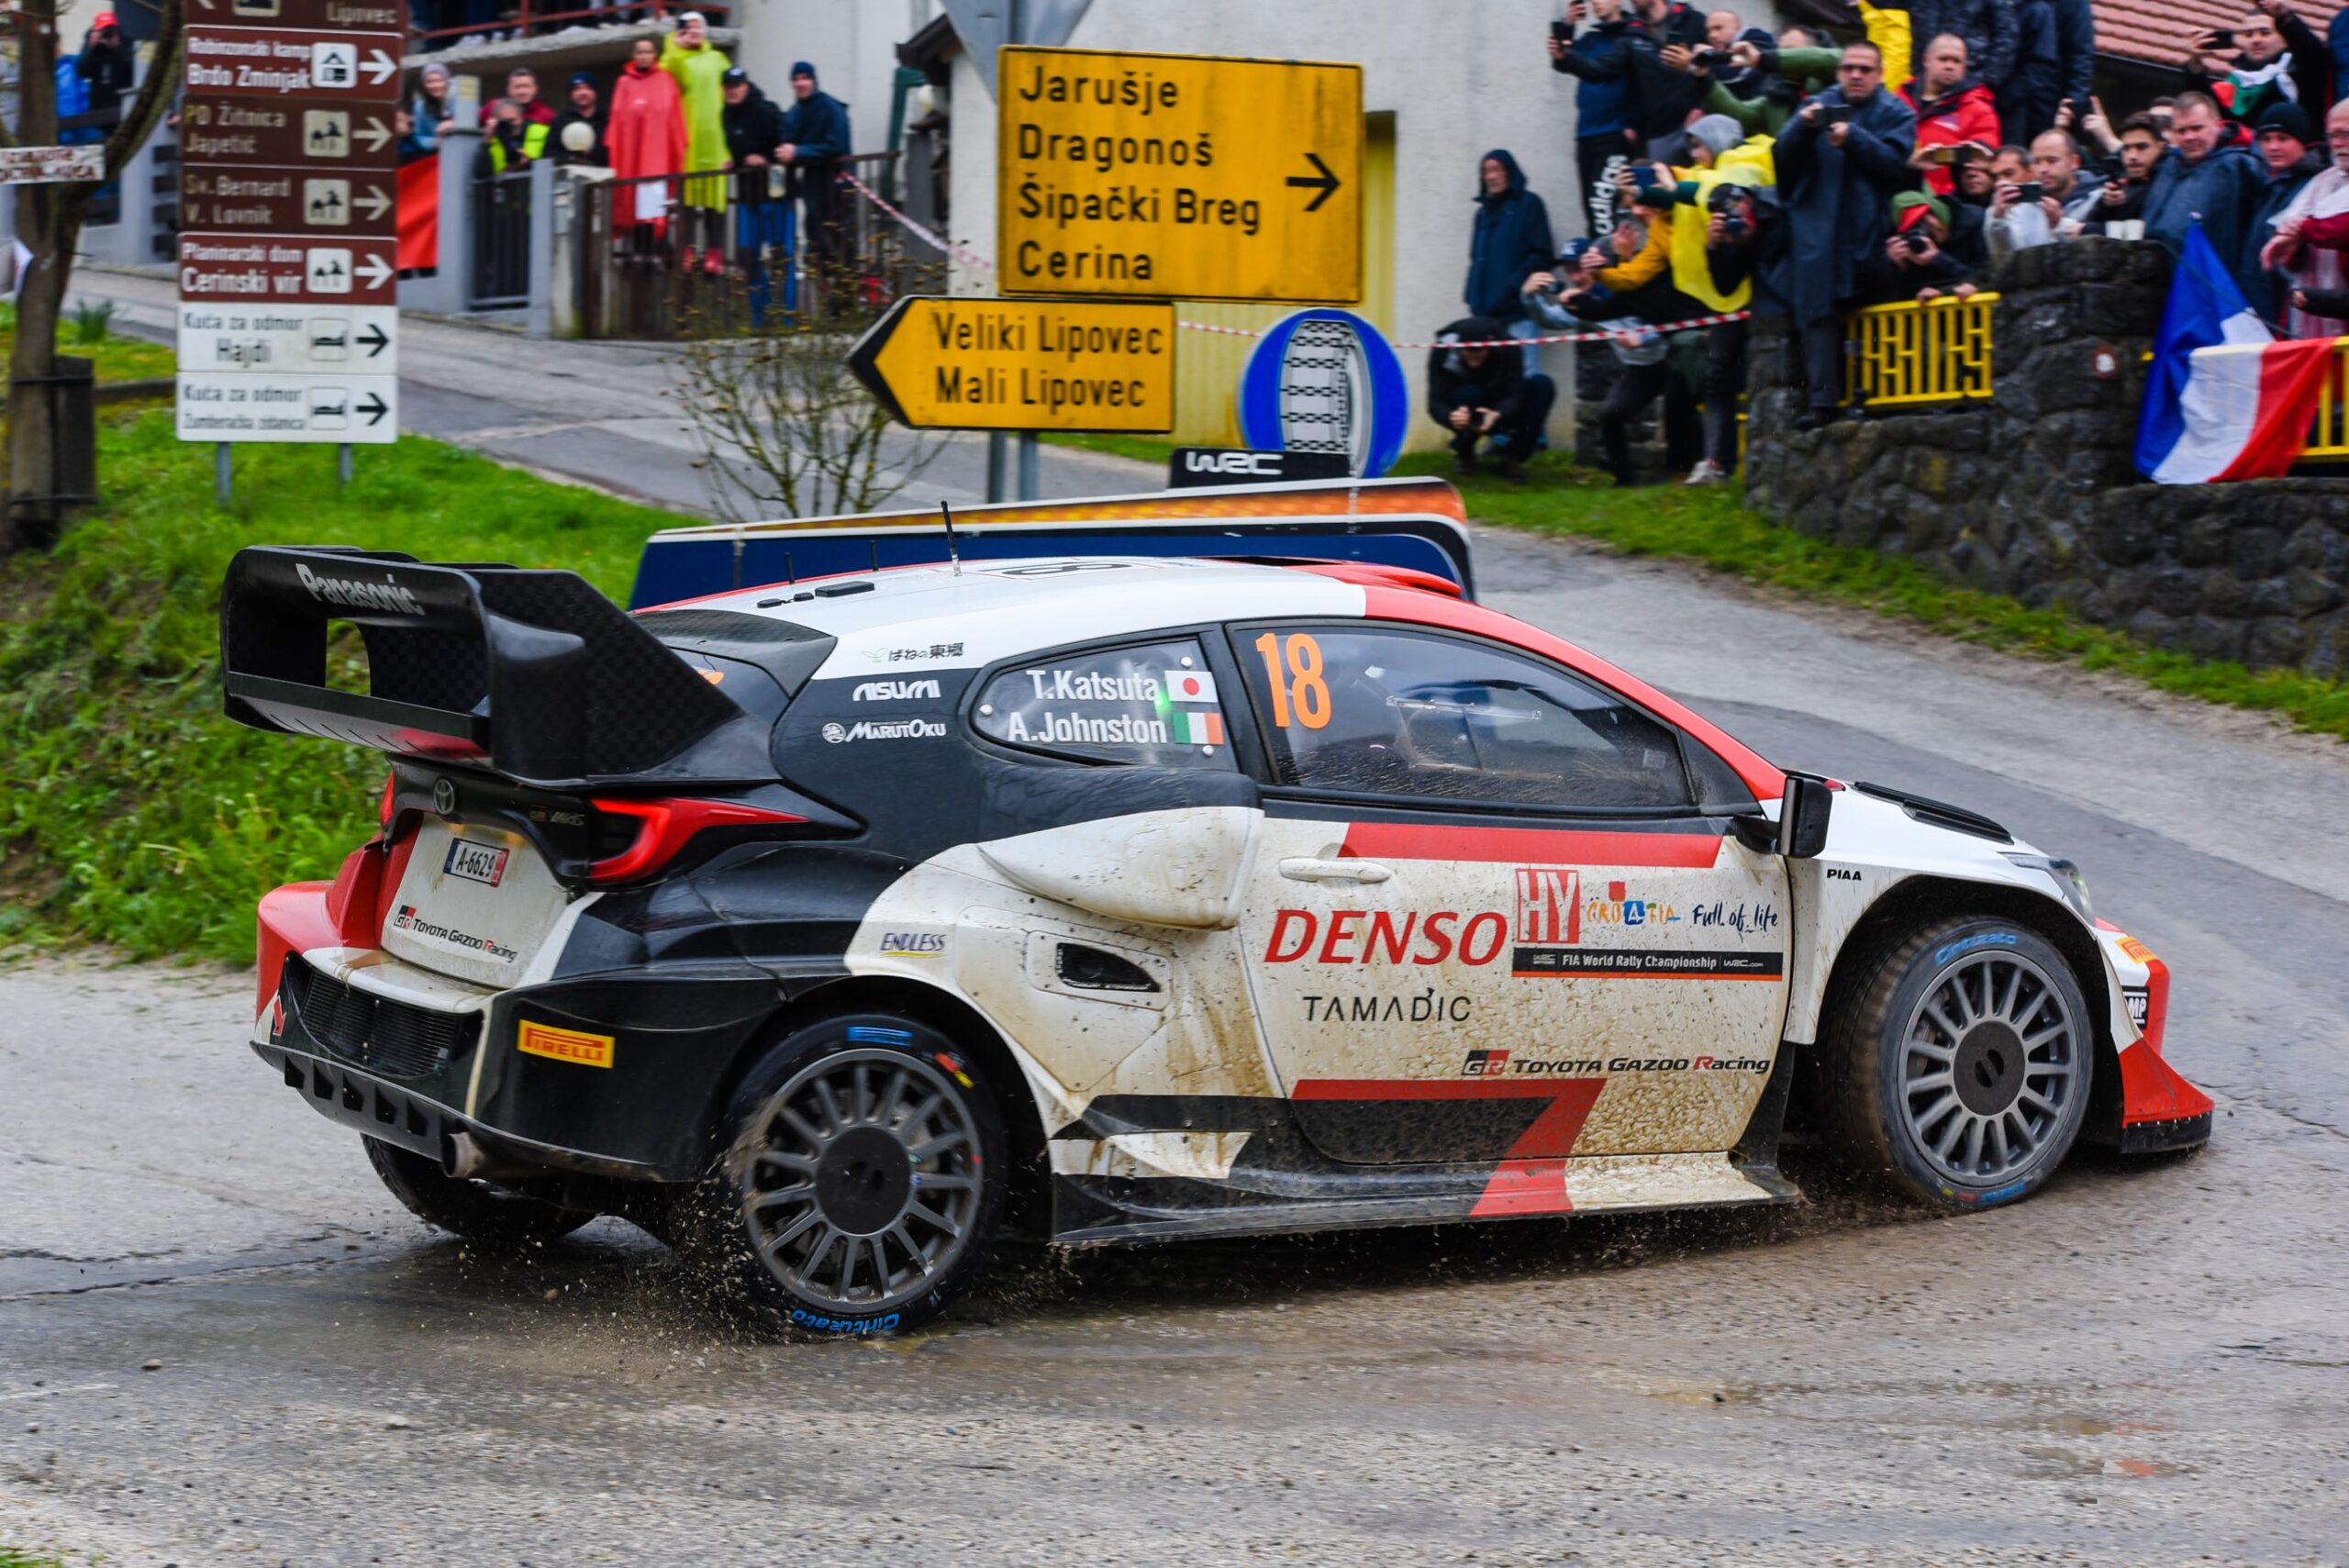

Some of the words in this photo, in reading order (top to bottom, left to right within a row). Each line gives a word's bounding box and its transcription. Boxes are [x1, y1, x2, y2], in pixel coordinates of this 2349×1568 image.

[1019, 65, 1179, 117] Jarušje
[1019, 123, 1214, 172] Dragonoš
[217, 175, 292, 196] Bernard
[1019, 172, 1161, 228] Šipački
[1174, 188, 1261, 237] Breg
[269, 244, 304, 262] dom
[1018, 240, 1153, 281] Cerina
[182, 266, 269, 294] Cerinski
[273, 269, 304, 294] vir
[228, 317, 247, 330] za
[934, 312, 1028, 354] Veliki
[1039, 316, 1163, 361] Lipovec
[228, 389, 247, 402] za
[935, 365, 1007, 406] Mali
[1019, 367, 1146, 416] Lipovec
[1186, 450, 1284, 475] WRC
[295, 562, 426, 617] Panasonic
[1026, 670, 1161, 702] T.Katsuta
[1255, 632, 1332, 729] 18
[1008, 711, 1168, 744] A.Johnston
[455, 847, 496, 879] A-6629
[1826, 868, 1863, 882] PIAA
[1753, 903, 1779, 931] life
[412, 917, 449, 940] TOYOTA
[448, 929, 484, 951] GAZOO
[483, 940, 518, 962] Racing
[880, 932, 947, 951] ENDLESS
[1264, 908, 1508, 966] DENSO
[1562, 954, 1580, 966] FIA
[1583, 955, 1613, 967] World
[1616, 956, 1642, 970] Rally
[1645, 956, 1717, 971] Championship
[1303, 995, 1471, 1023] TAMADIC
[2124, 996, 2147, 1018] MP
[526, 1028, 604, 1062] PIRELLI
[1461, 1060, 1507, 1075] GR
[1514, 1059, 1603, 1073] TOYOTA
[1608, 1057, 1691, 1073] GAZOO
[1693, 1055, 1771, 1074] Racing
[791, 1309, 899, 1334] Cinturato
